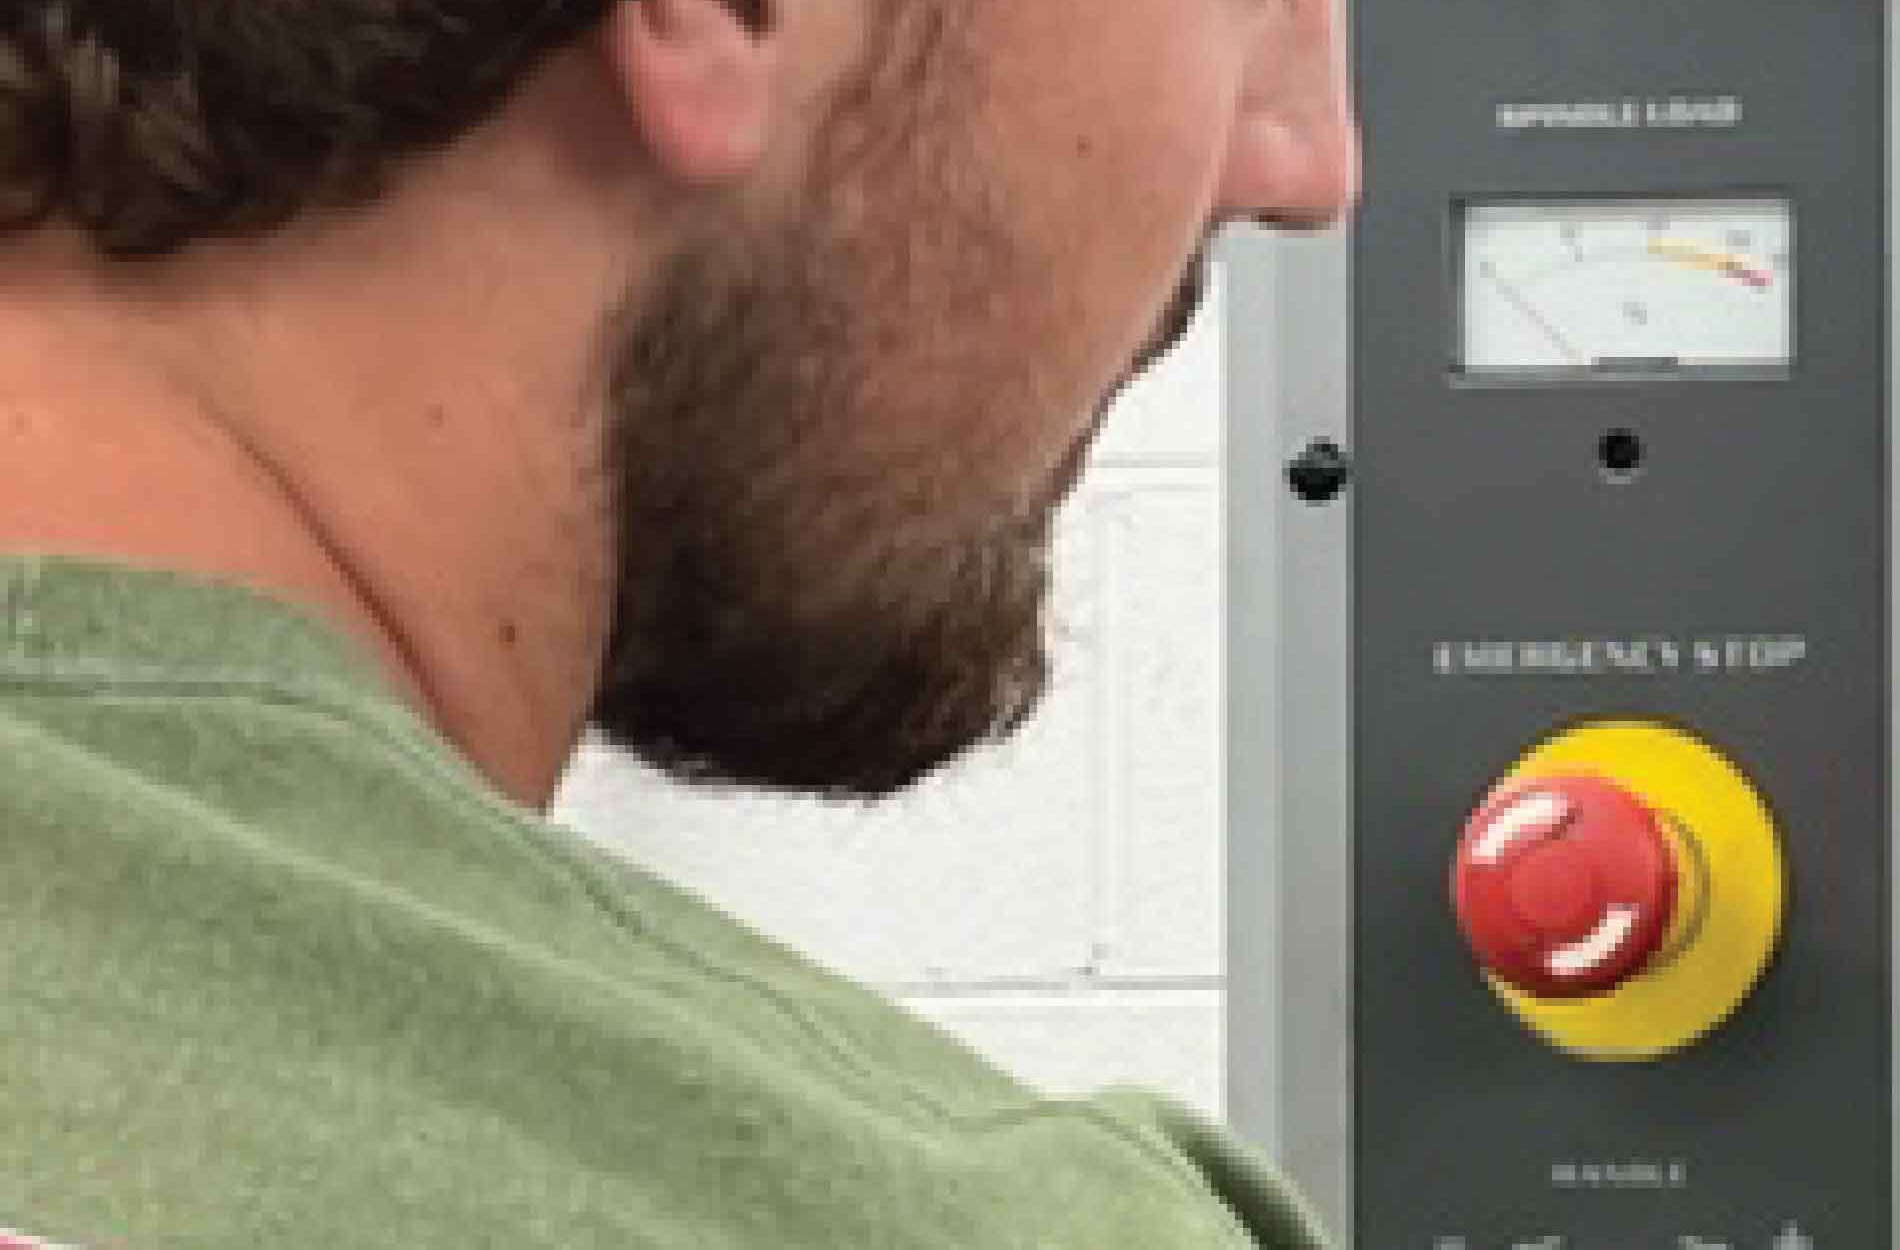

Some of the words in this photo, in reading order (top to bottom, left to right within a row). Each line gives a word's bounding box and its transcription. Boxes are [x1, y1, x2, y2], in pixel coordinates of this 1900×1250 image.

[1496, 103, 1637, 129] SPINDLE
[1645, 96, 1743, 128] LOAD
[1432, 641, 1681, 674] EMERGENCY
[1694, 634, 1806, 672] STOP
